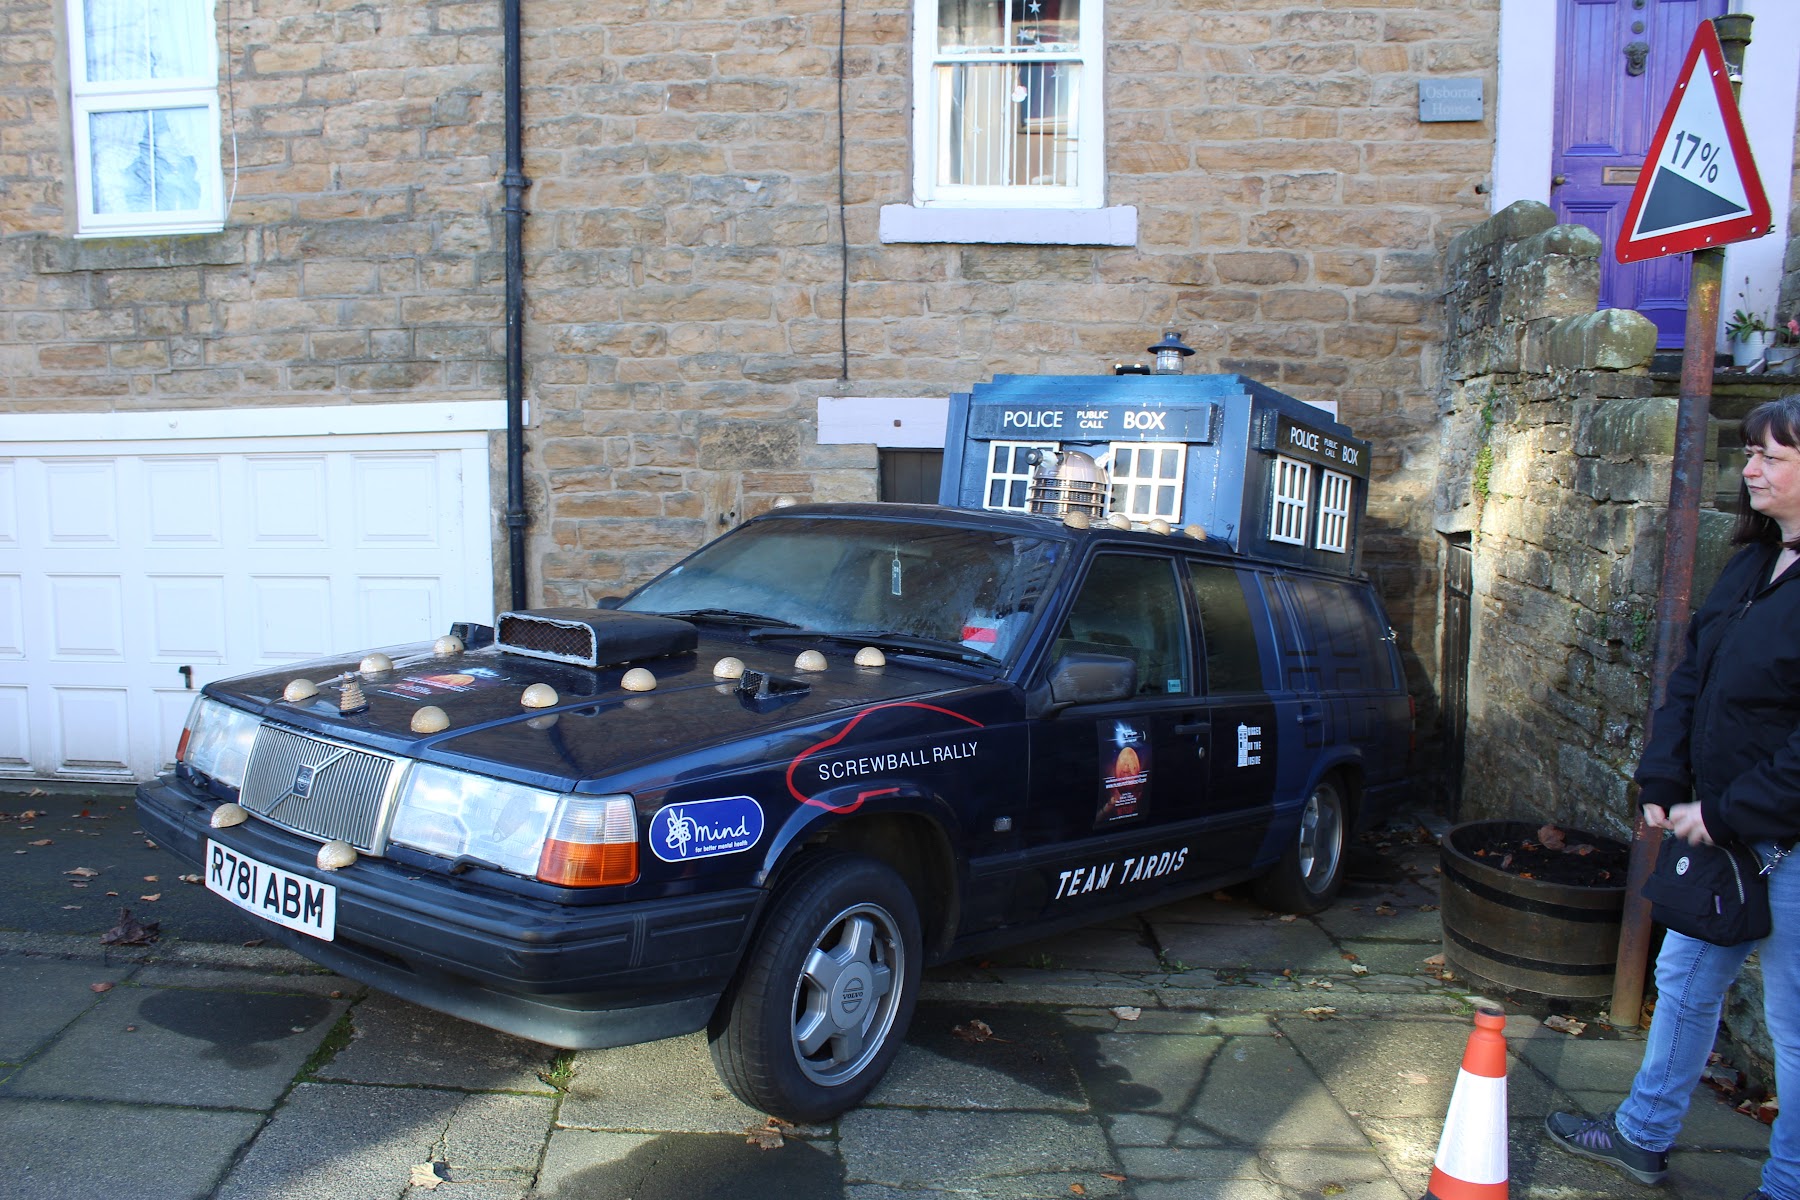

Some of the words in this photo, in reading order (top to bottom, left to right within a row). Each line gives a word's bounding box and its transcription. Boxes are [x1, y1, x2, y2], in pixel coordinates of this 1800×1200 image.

[1425, 86, 1478, 99] Osborne
[1432, 102, 1472, 115] House
[1671, 130, 1721, 183] 17%
[1003, 411, 1063, 428] POLICE
[1077, 410, 1108, 419] PUBLIC
[1123, 411, 1166, 430] BOX
[1079, 420, 1104, 429] CALL
[1290, 426, 1320, 452] POLICE
[1323, 438, 1338, 450] PUBLIC
[1324, 449, 1336, 458] CALL
[1342, 445, 1359, 466] BOX
[818, 750, 930, 781] SCREWBALL
[932, 741, 978, 763] RALLY
[694, 815, 750, 842] mind
[718, 842, 733, 850] mental
[734, 839, 748, 848] health
[1055, 862, 1115, 900] TEAM
[1120, 847, 1189, 885] TARDIS
[212, 845, 258, 904] R781
[263, 872, 325, 928] ABM
[842, 991, 864, 1000] VOLVO
